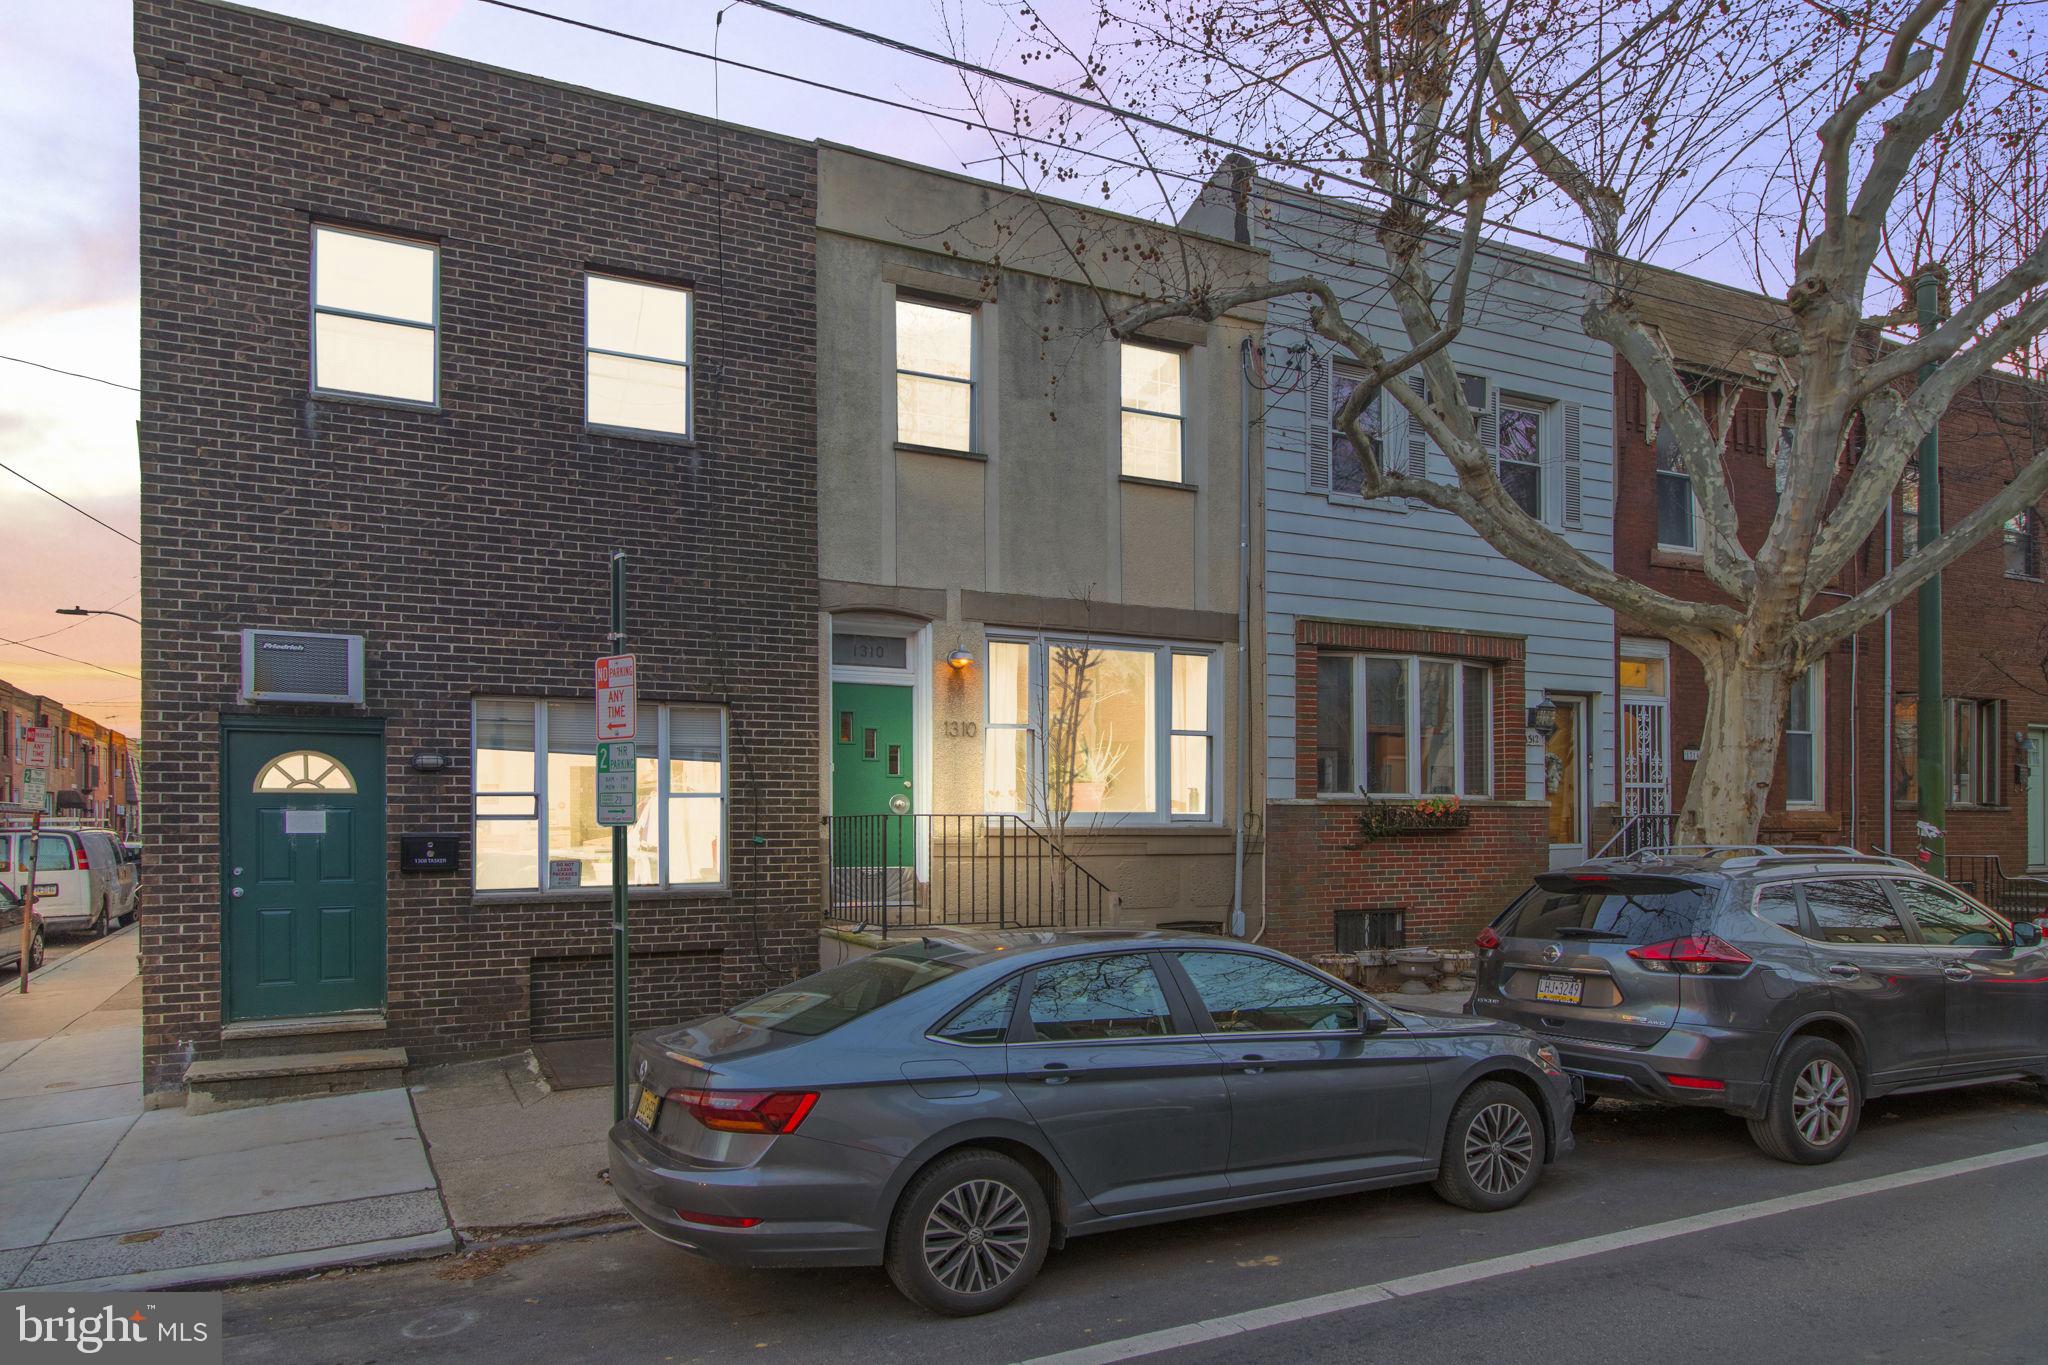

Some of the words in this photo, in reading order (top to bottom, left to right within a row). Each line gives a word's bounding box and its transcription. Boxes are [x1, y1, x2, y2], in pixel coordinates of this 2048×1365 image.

[263, 642, 304, 651] Friedrich
[853, 644, 884, 658] 1310
[598, 667, 608, 682] NO
[609, 665, 633, 678] PARKING
[608, 689, 625, 703] ANY
[607, 705, 626, 719] TIME
[944, 720, 977, 738] 1310
[600, 748, 608, 769] 2
[617, 745, 628, 756] HR
[610, 758, 635, 770] PARKING
